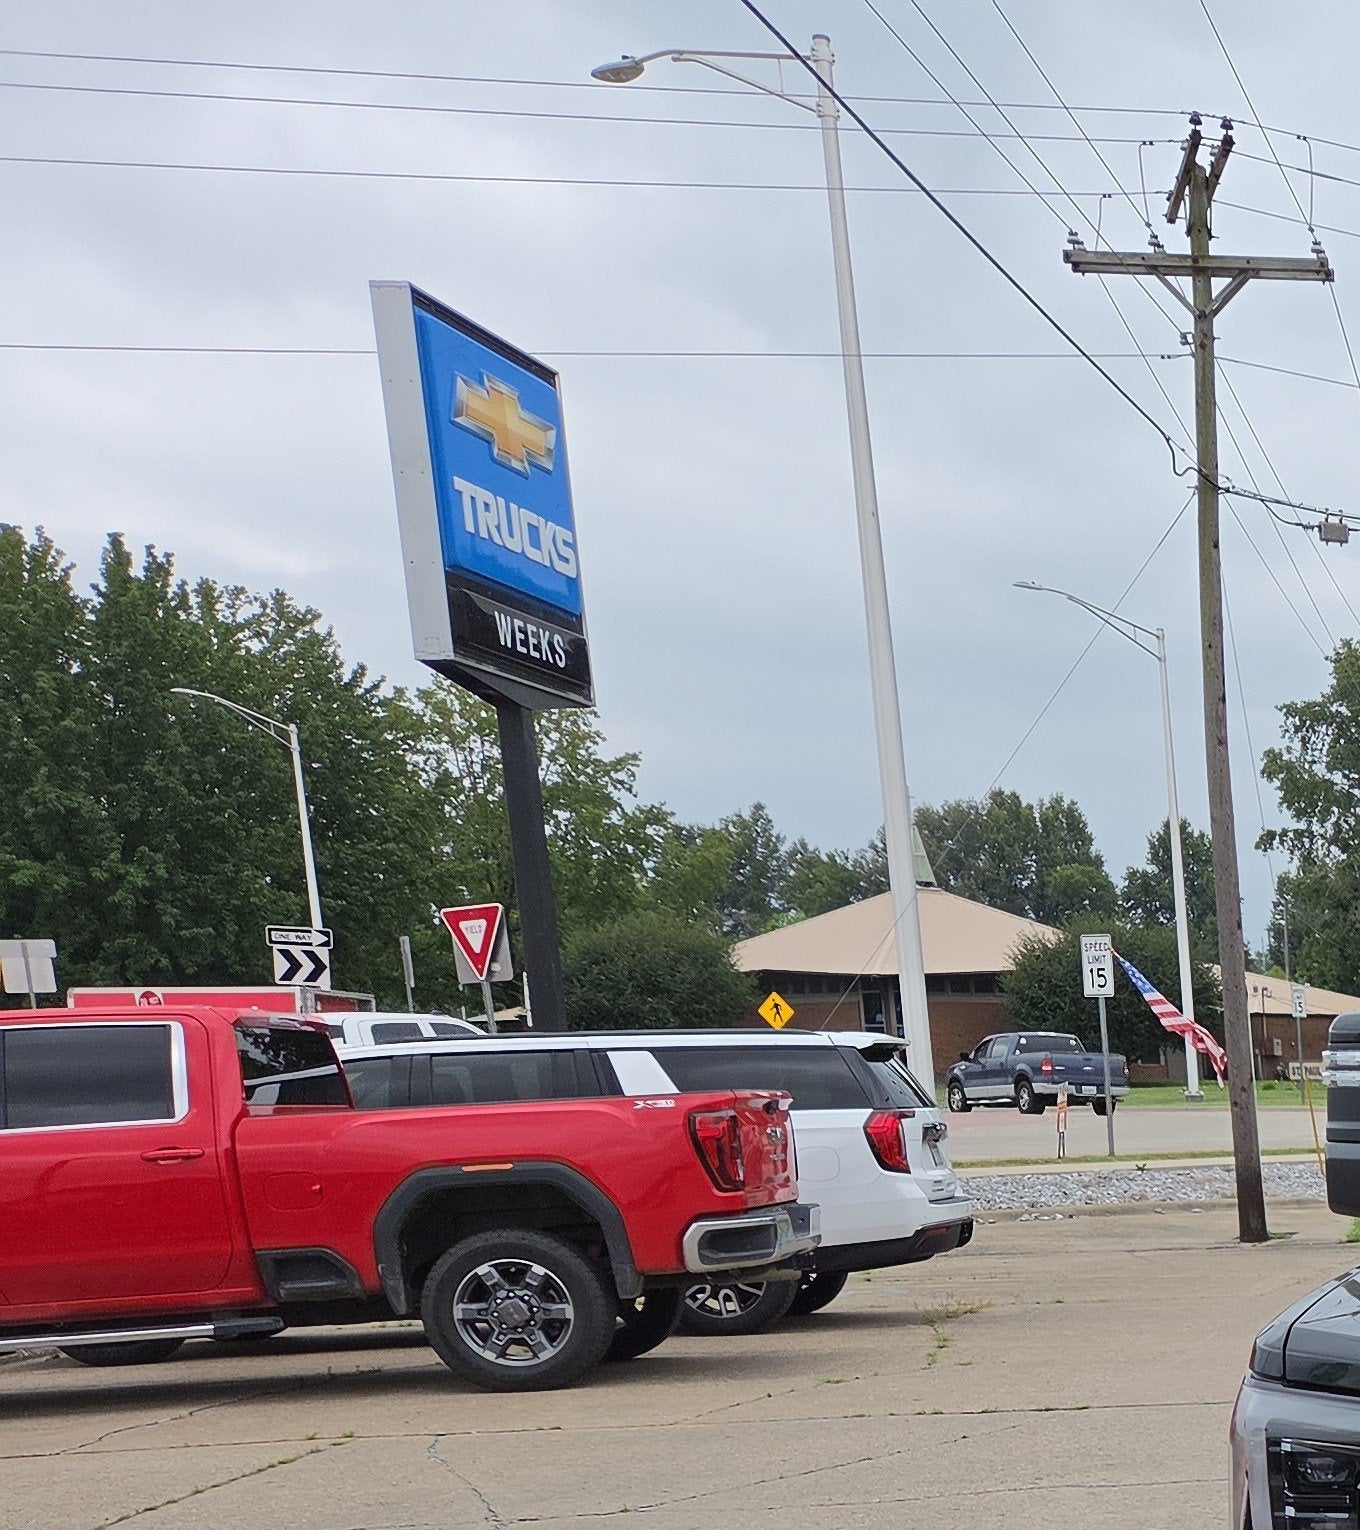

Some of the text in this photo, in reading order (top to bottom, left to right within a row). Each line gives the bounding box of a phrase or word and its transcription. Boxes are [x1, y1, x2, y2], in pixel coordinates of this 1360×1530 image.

[453, 476, 577, 580] TRUCKS
[494, 610, 567, 669] WEEKS
[1084, 943, 1108, 952] SPEED
[1088, 955, 1106, 965] LIMIT
[1090, 968, 1107, 988] 15
